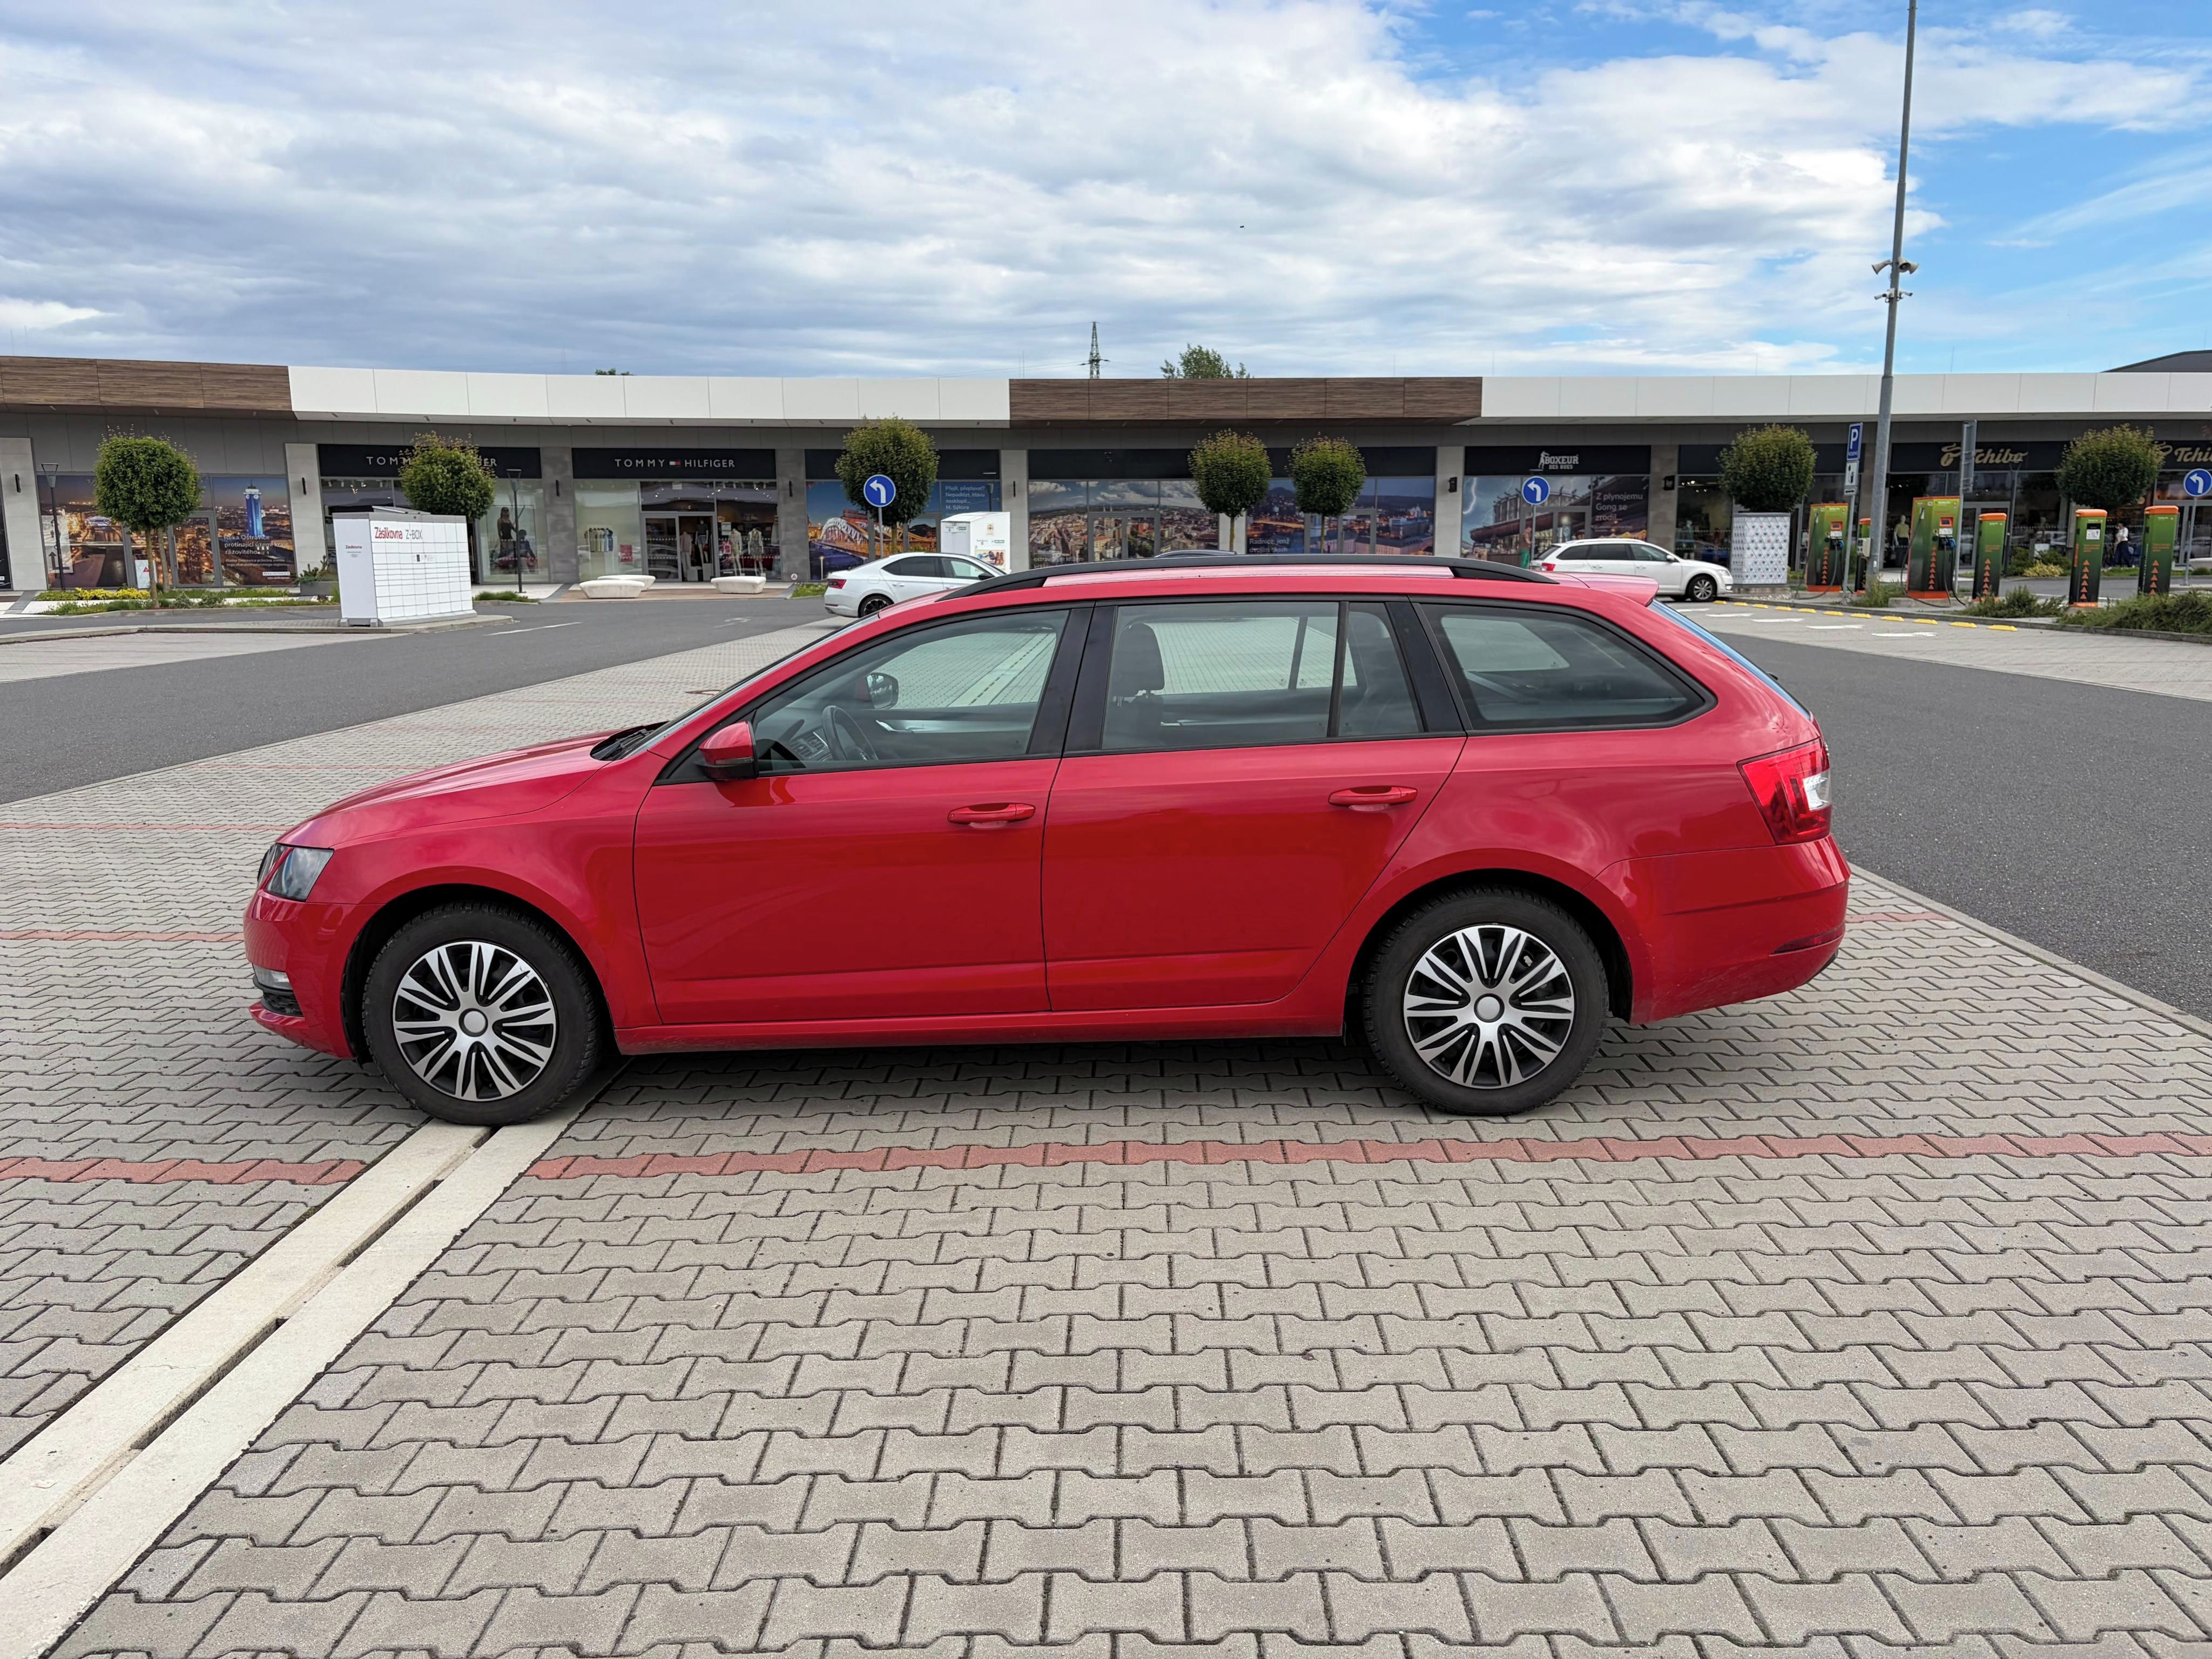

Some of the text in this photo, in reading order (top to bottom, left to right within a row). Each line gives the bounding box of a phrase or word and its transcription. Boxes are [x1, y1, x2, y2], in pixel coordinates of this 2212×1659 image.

[1850, 429, 1858, 449] P
[1975, 449, 2028, 463] chibo
[2174, 447, 2212, 462] Tchi
[366, 456, 412, 465] TOMM
[615, 459, 665, 467] TOMMY
[1545, 456, 1579, 464] BOXEUR
[1603, 493, 1643, 501] plynojemu
[1595, 503, 1616, 511] Gong
[374, 527, 423, 539] Zásilkovna Z-BOX
